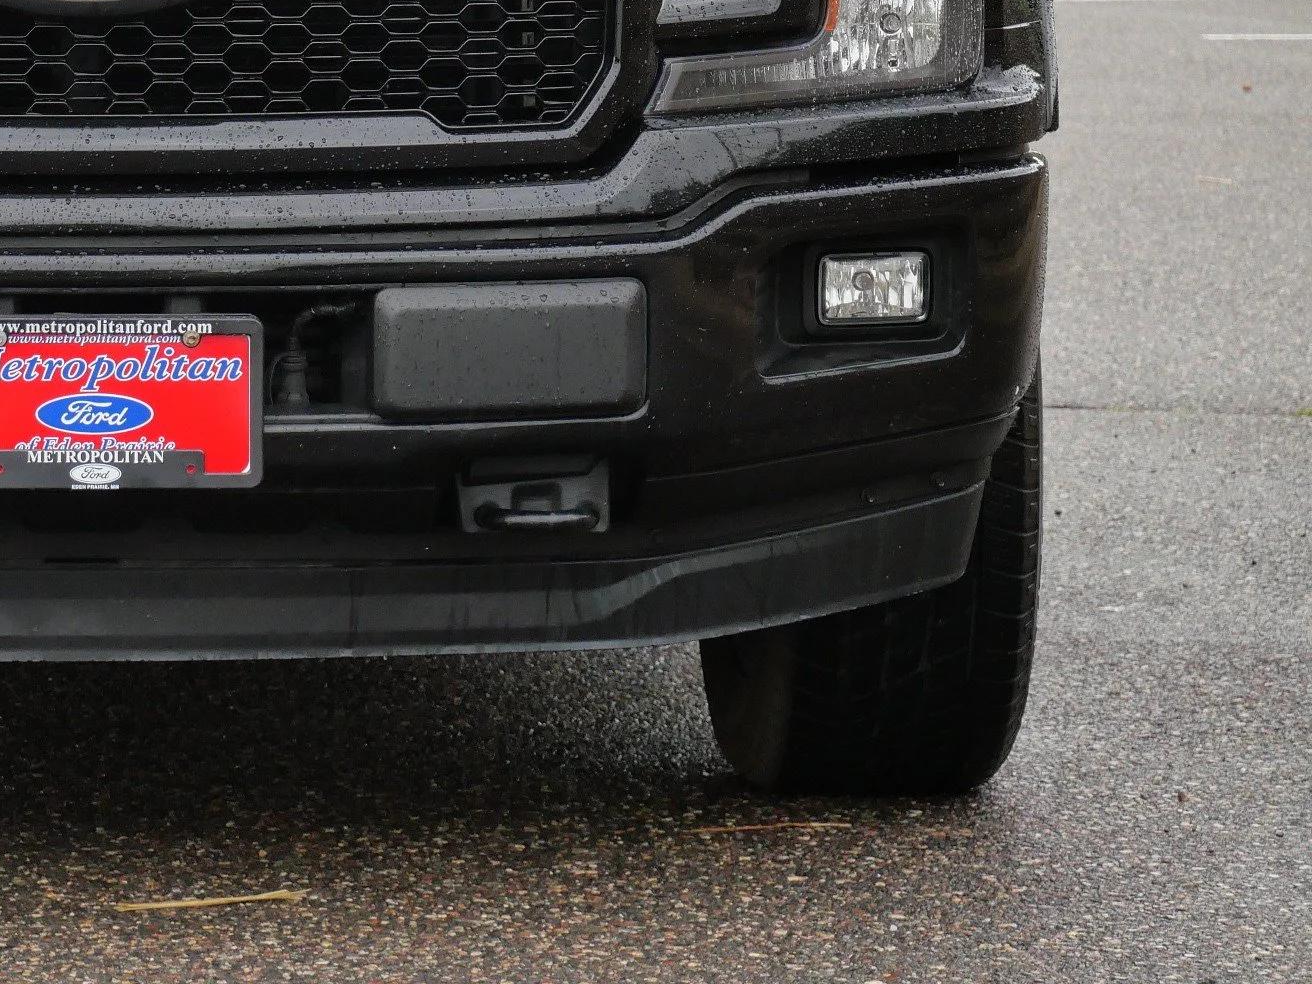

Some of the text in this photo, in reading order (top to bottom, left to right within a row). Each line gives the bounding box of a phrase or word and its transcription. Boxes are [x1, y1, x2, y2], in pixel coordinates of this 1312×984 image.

[60, 400, 128, 426] Ford
[27, 450, 165, 464] METROPOLITAN
[81, 466, 110, 479] Ford
